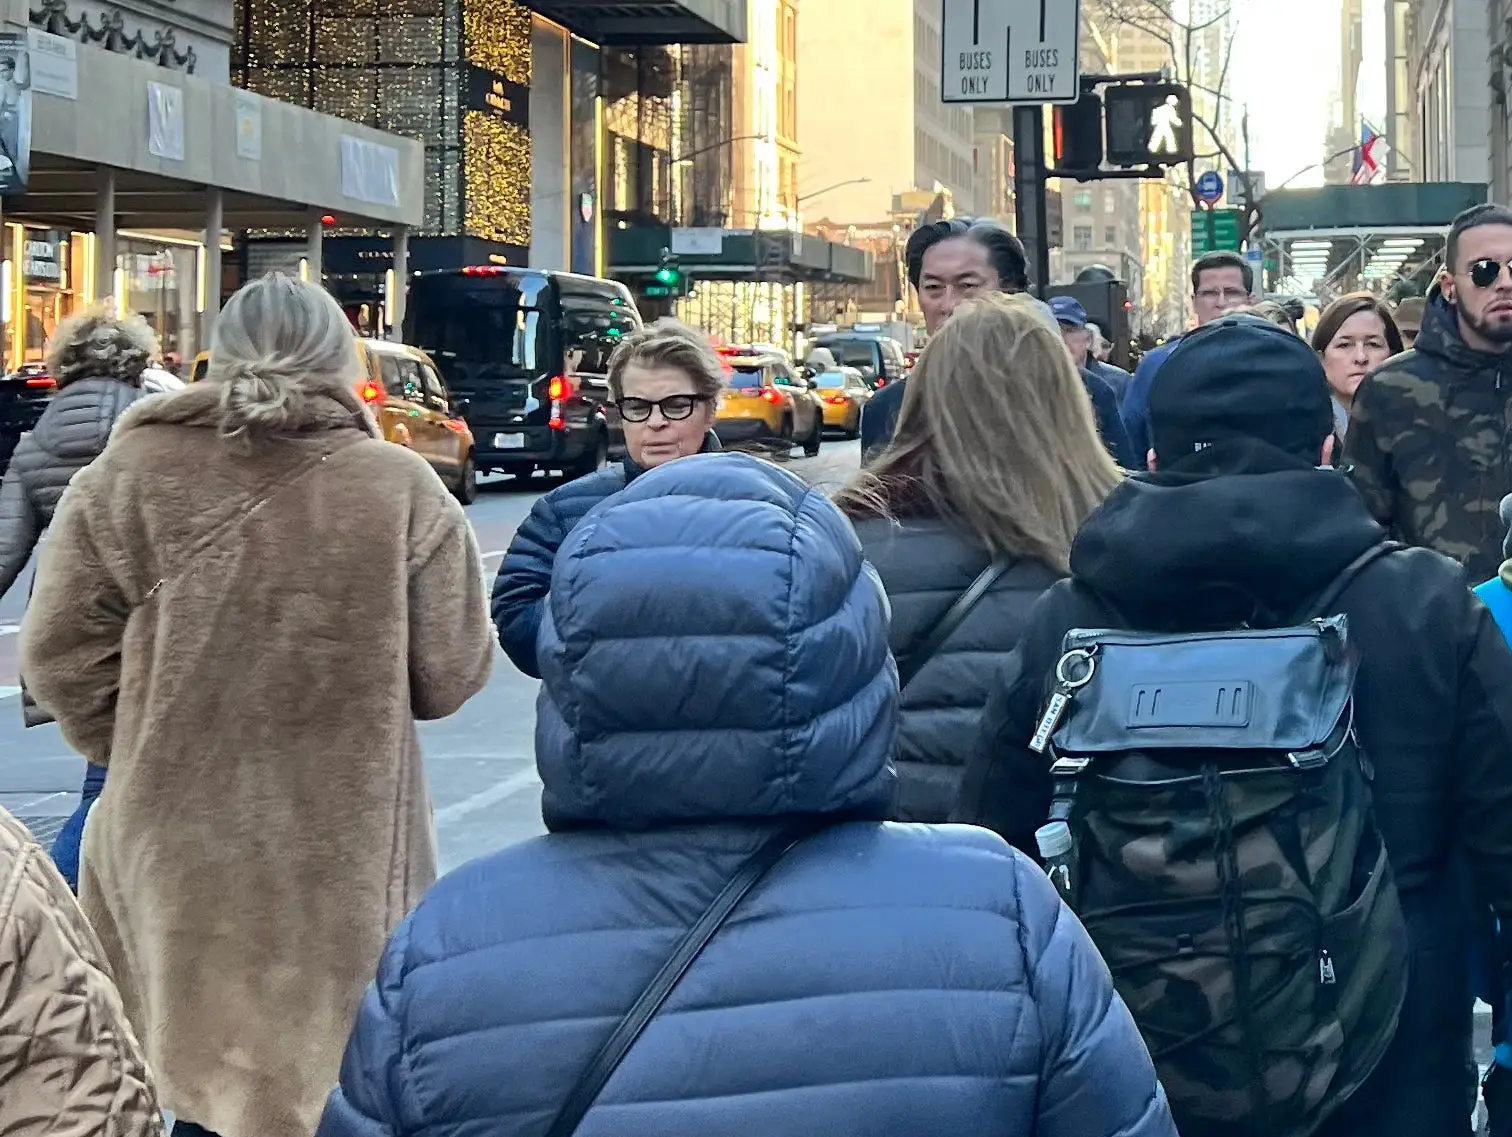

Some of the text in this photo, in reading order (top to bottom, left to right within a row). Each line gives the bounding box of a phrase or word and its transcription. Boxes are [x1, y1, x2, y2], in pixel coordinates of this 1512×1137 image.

[959, 51, 992, 70] BUSES
[1025, 49, 1059, 68] BUSES
[961, 76, 989, 95] ONLY
[1027, 74, 1055, 93] ONLY
